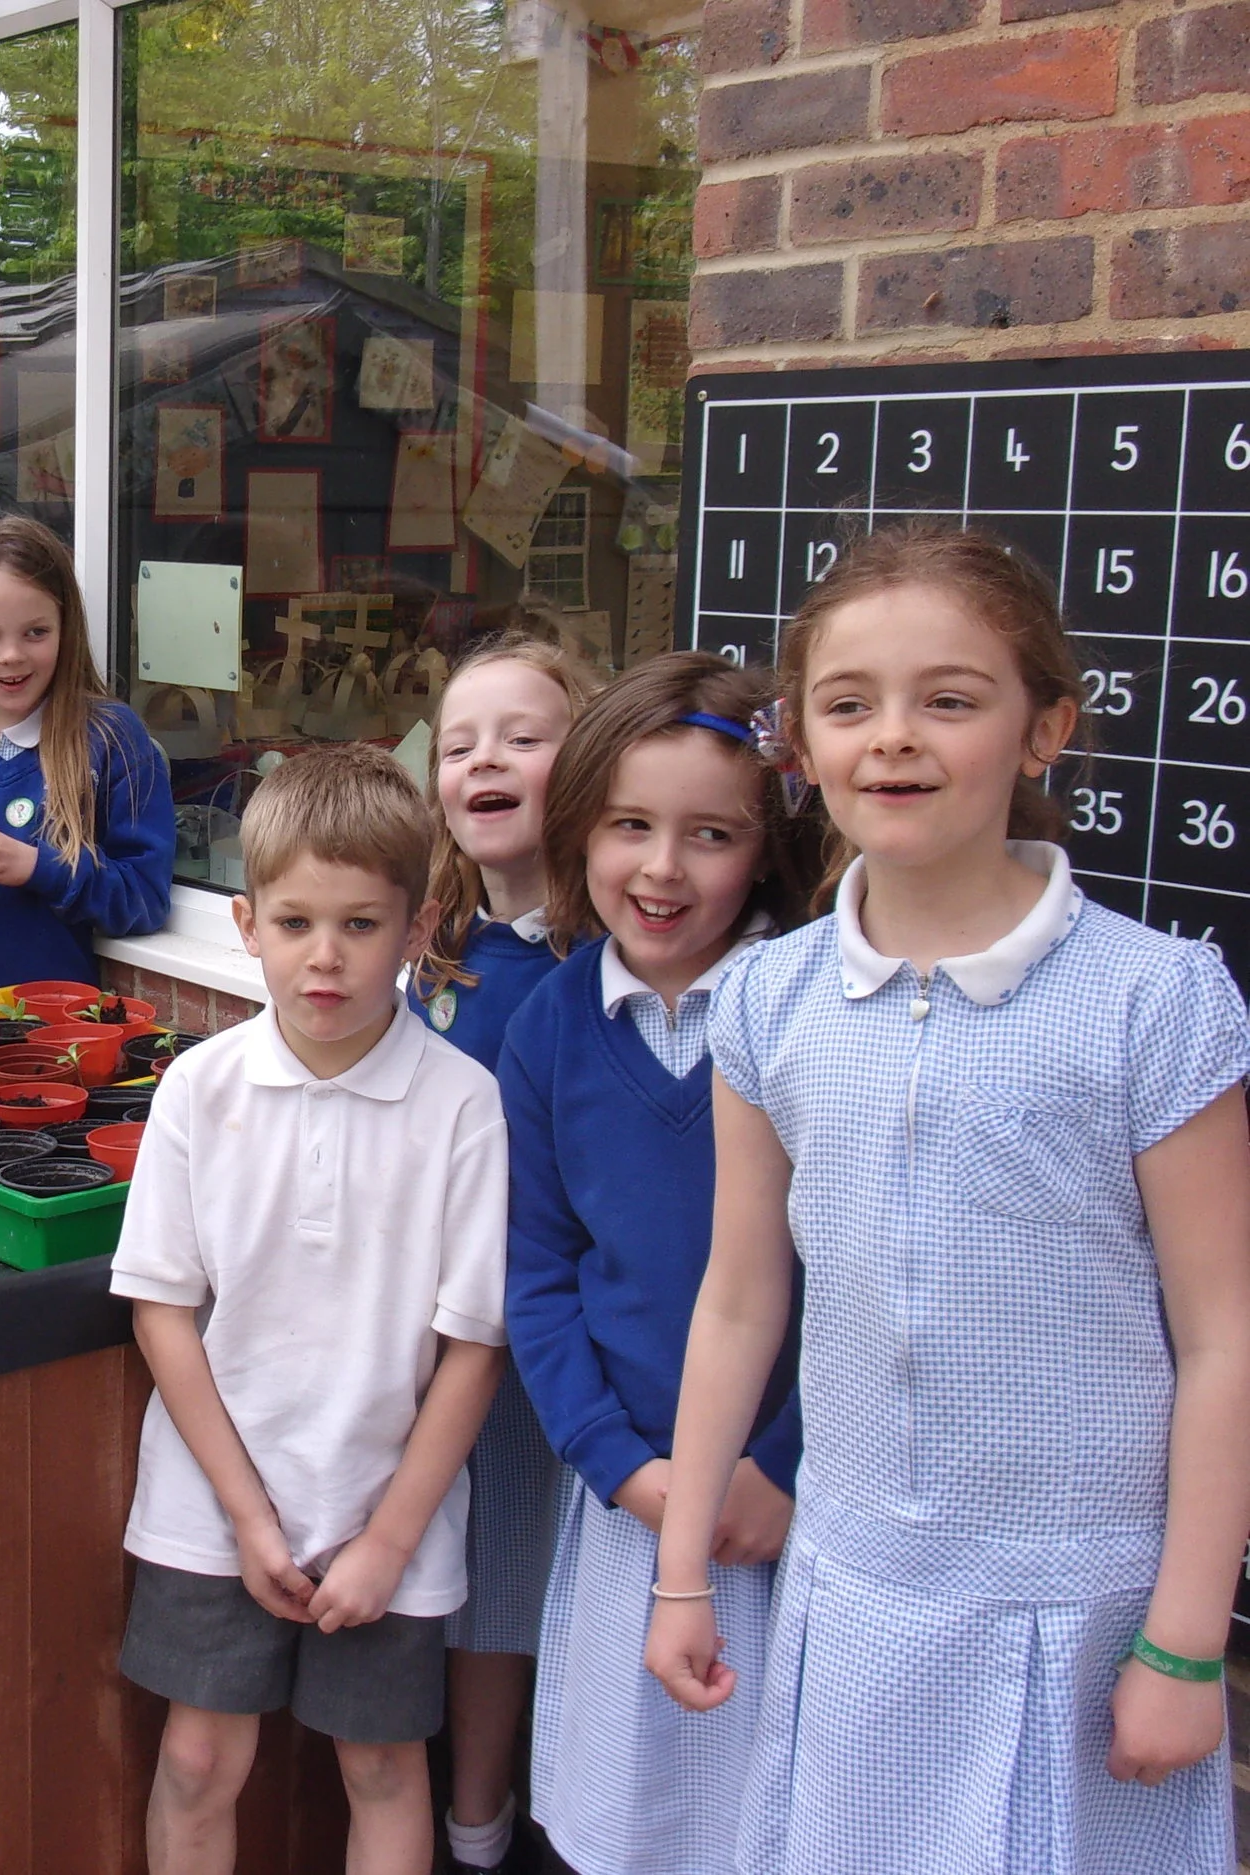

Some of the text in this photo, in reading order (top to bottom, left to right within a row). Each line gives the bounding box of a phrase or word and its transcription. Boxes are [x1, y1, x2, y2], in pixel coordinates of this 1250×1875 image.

[738, 423, 1250, 474] 1 2 3 4 5 6
[728, 539, 1248, 598] 11 12 15 16
[1081, 669, 1133, 716] 25
[1188, 676, 1246, 725] 26
[1070, 787, 1235, 849] 35 36
